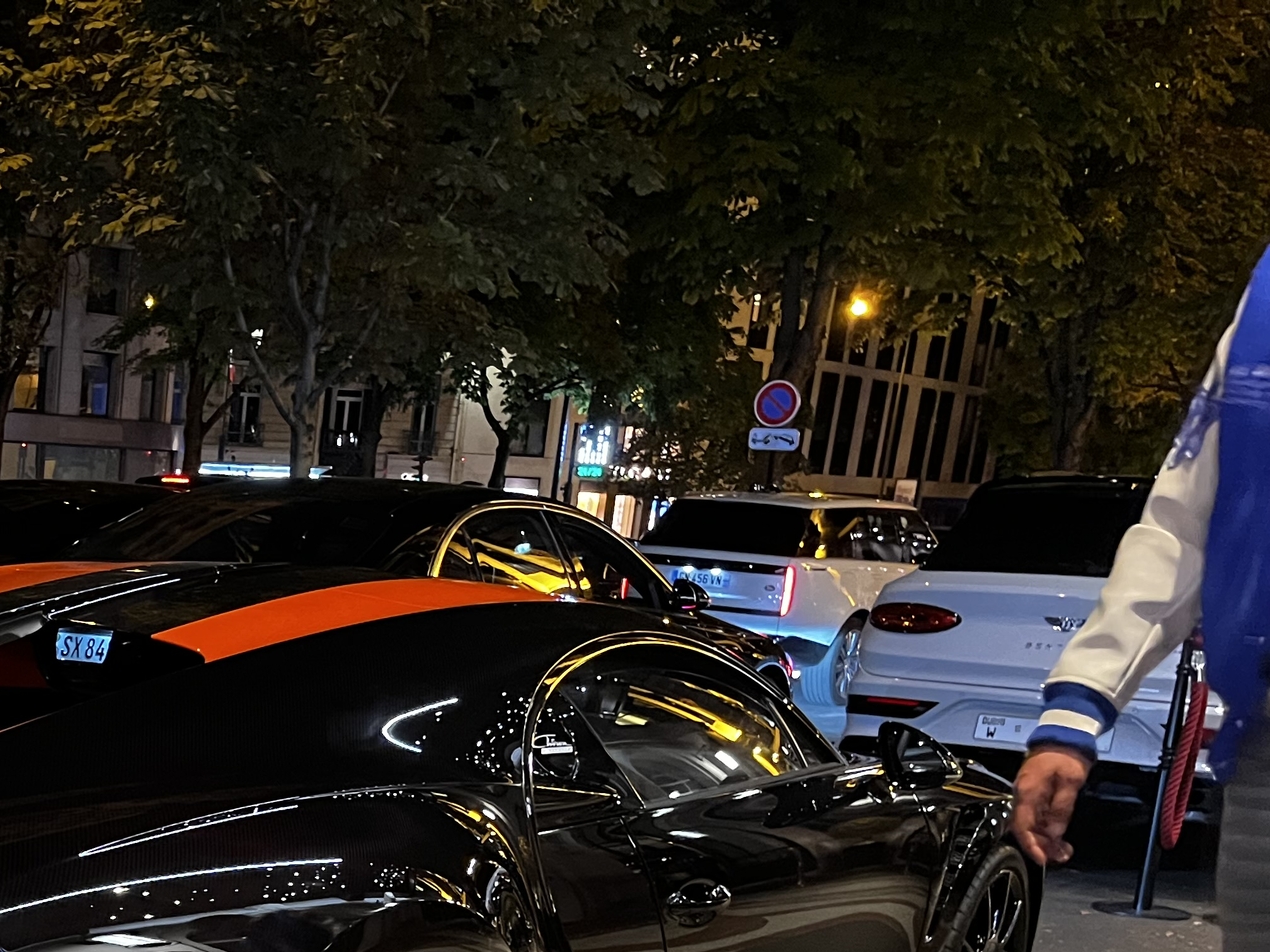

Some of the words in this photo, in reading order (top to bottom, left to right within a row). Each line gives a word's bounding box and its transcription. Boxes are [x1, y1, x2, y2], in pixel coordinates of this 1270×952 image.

[61, 636, 83, 658] SX
[85, 638, 105, 661] 84
[986, 726, 997, 738] W
